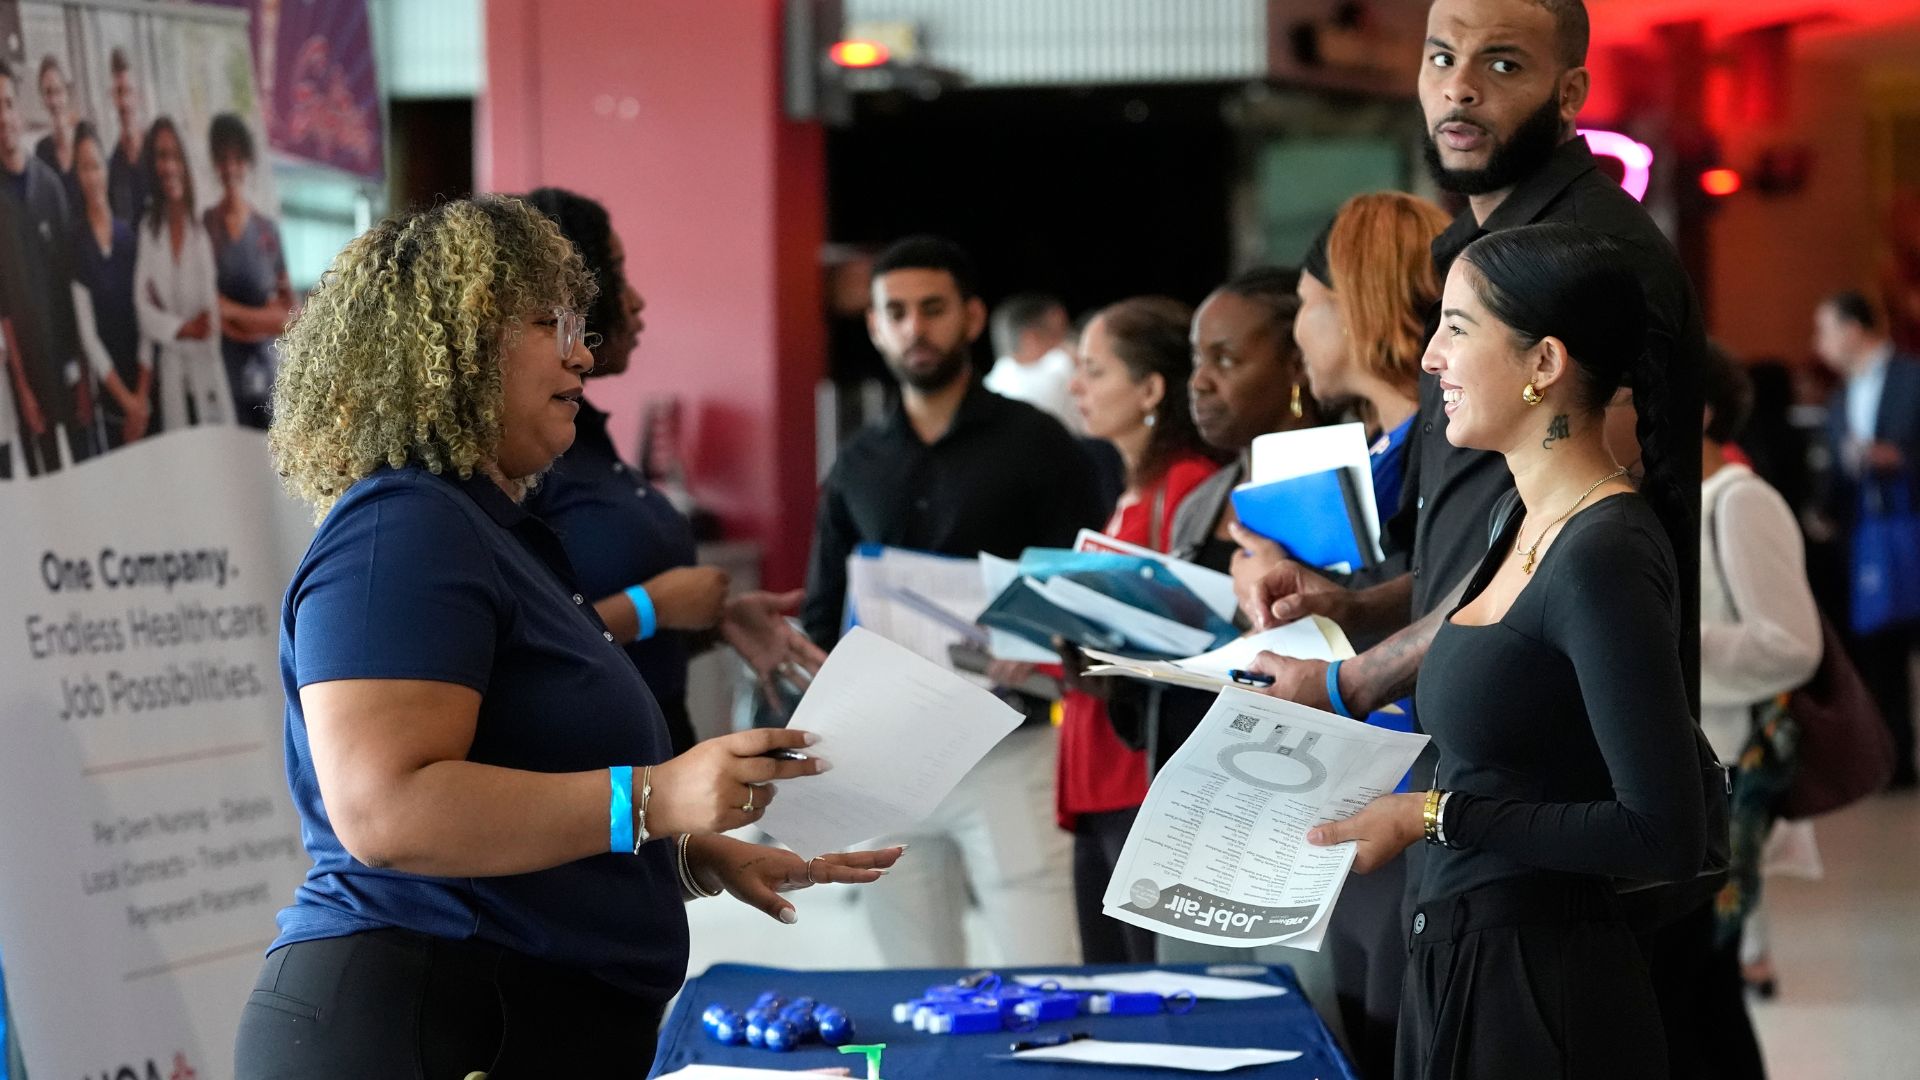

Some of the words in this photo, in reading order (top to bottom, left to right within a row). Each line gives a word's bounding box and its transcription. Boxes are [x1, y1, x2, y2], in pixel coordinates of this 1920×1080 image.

[40, 551, 94, 591] One
[98, 547, 240, 592] Company.
[25, 614, 125, 660] Endless
[127, 601, 270, 650] Healthcare
[60, 674, 104, 721] Job
[106, 661, 266, 712] Possibilities.
[1164, 895, 1263, 933] JobFair
